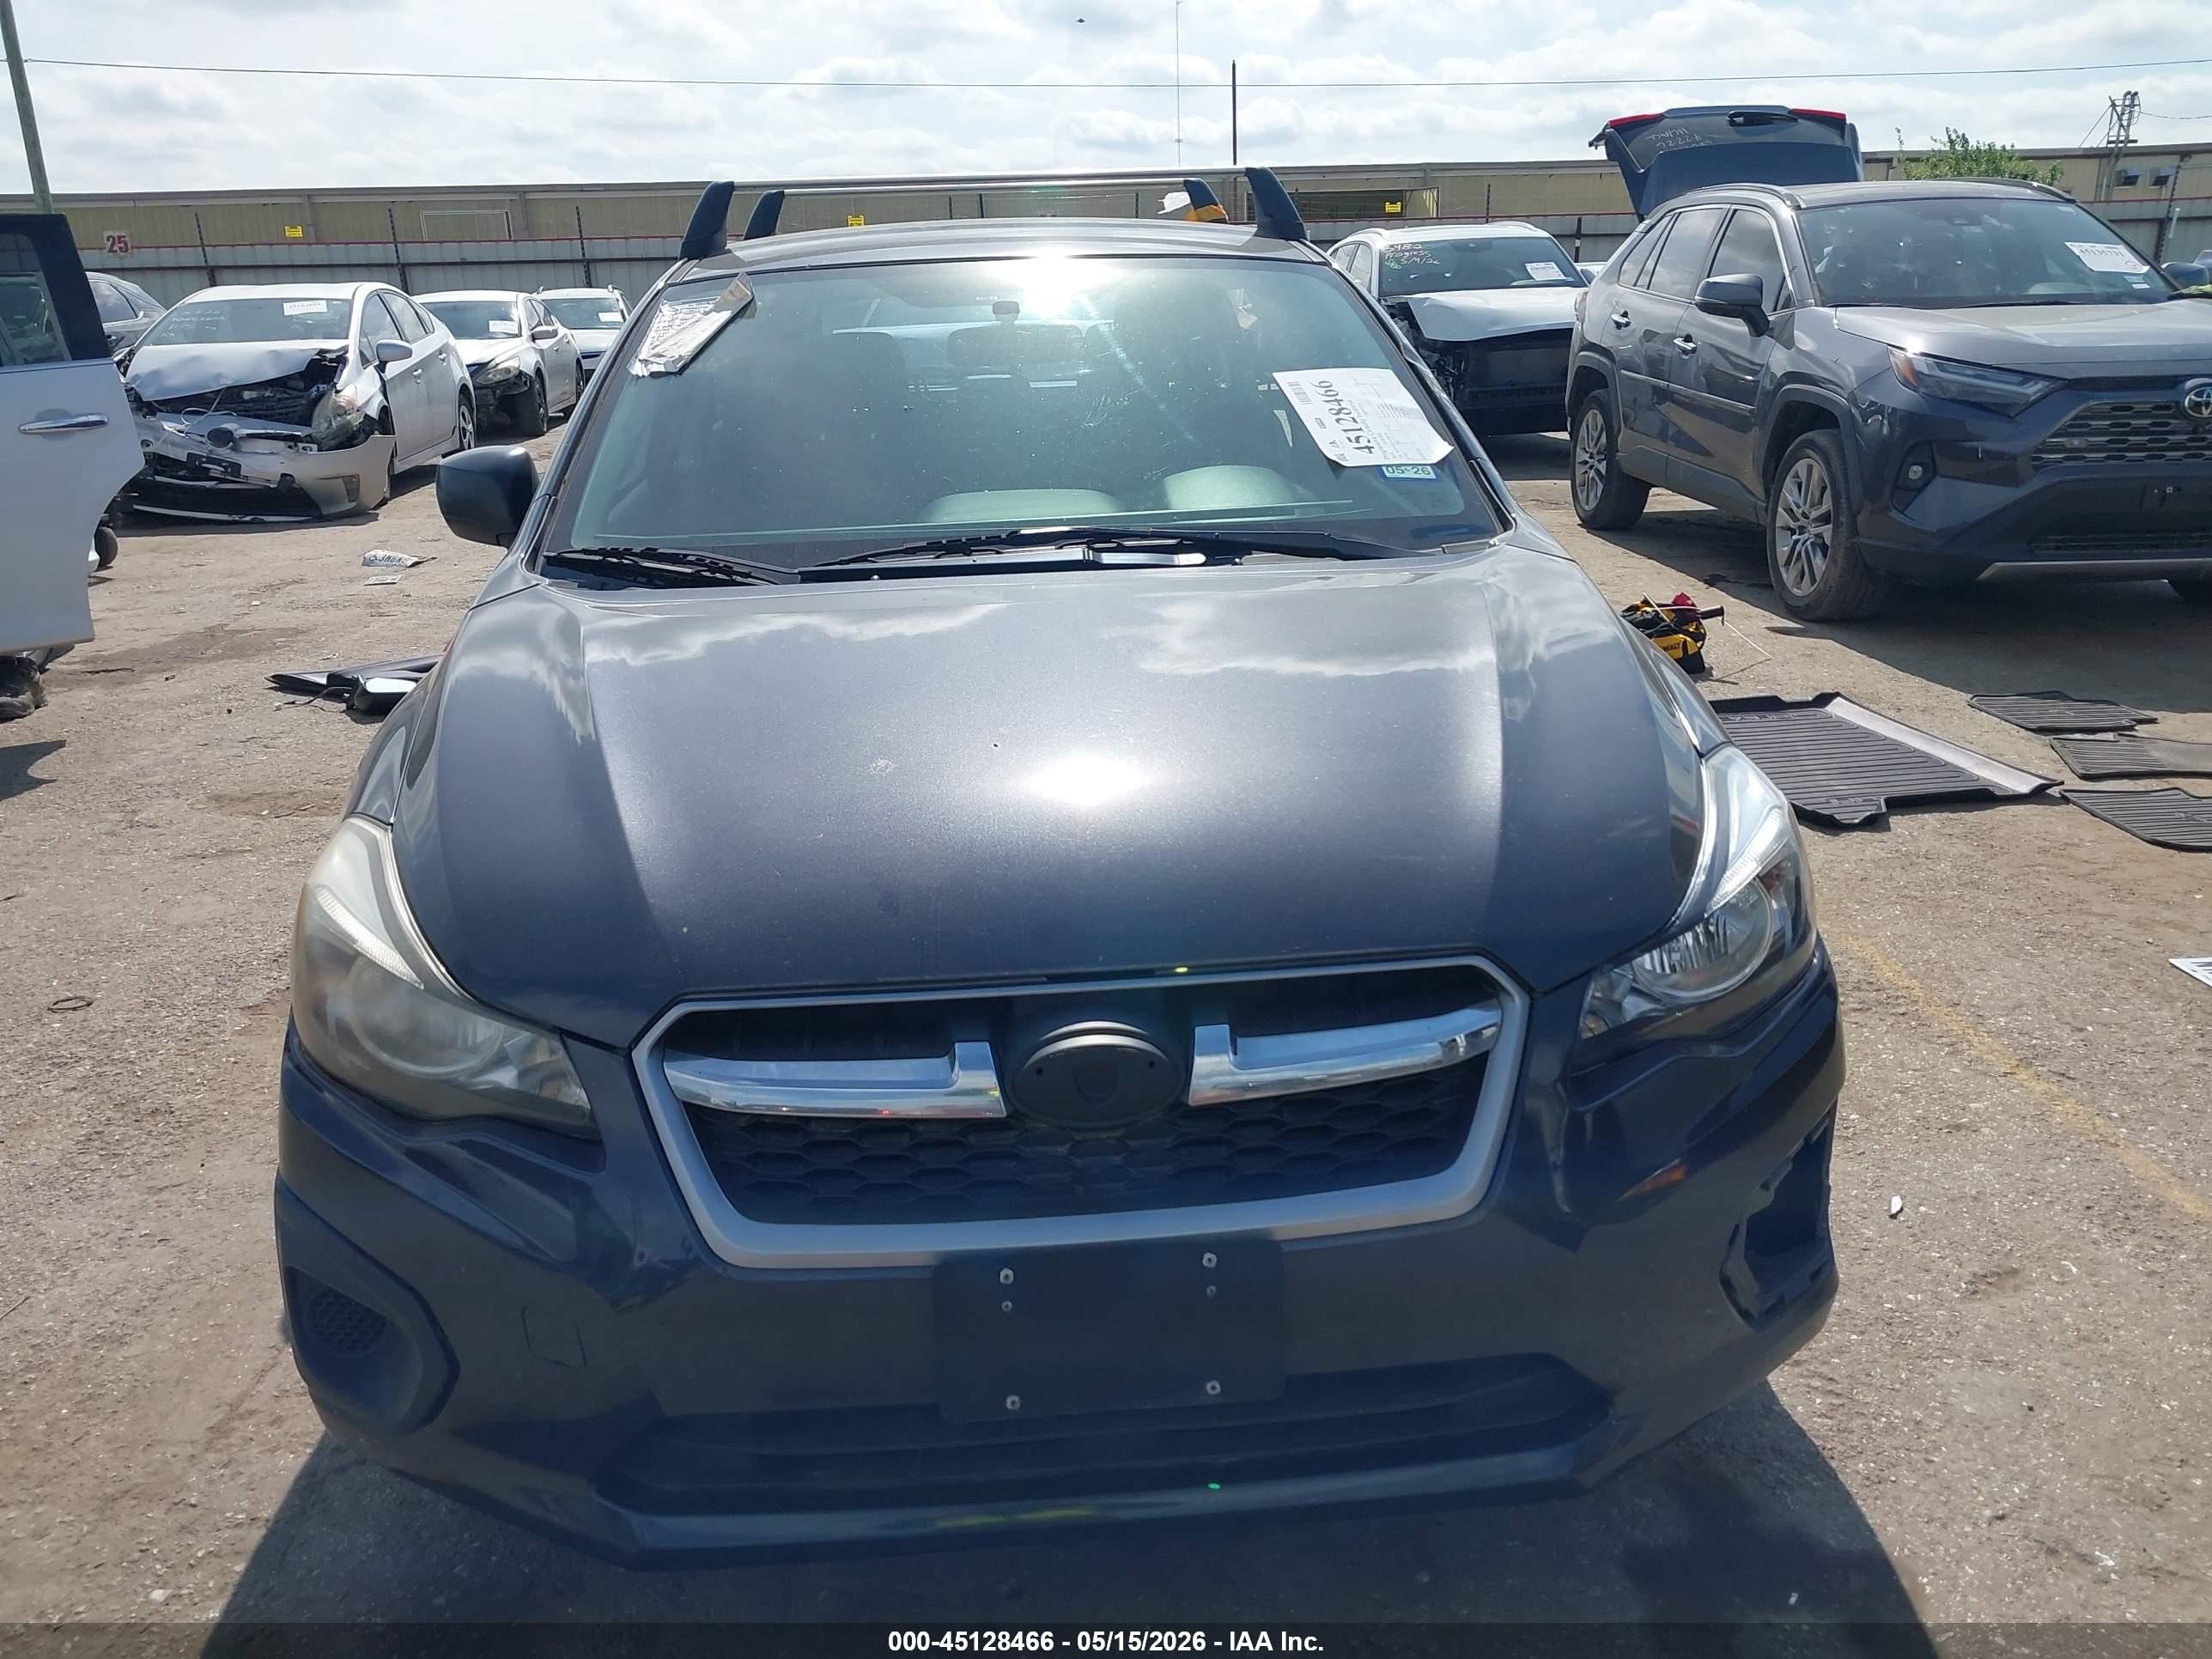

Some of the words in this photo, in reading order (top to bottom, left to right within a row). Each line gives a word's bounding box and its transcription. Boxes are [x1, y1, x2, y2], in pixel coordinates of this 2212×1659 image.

[106, 234, 130, 253] 25
[1310, 380, 1375, 454] 45128466
[1386, 465, 1405, 475] 05
[1412, 466, 1431, 476] 26
